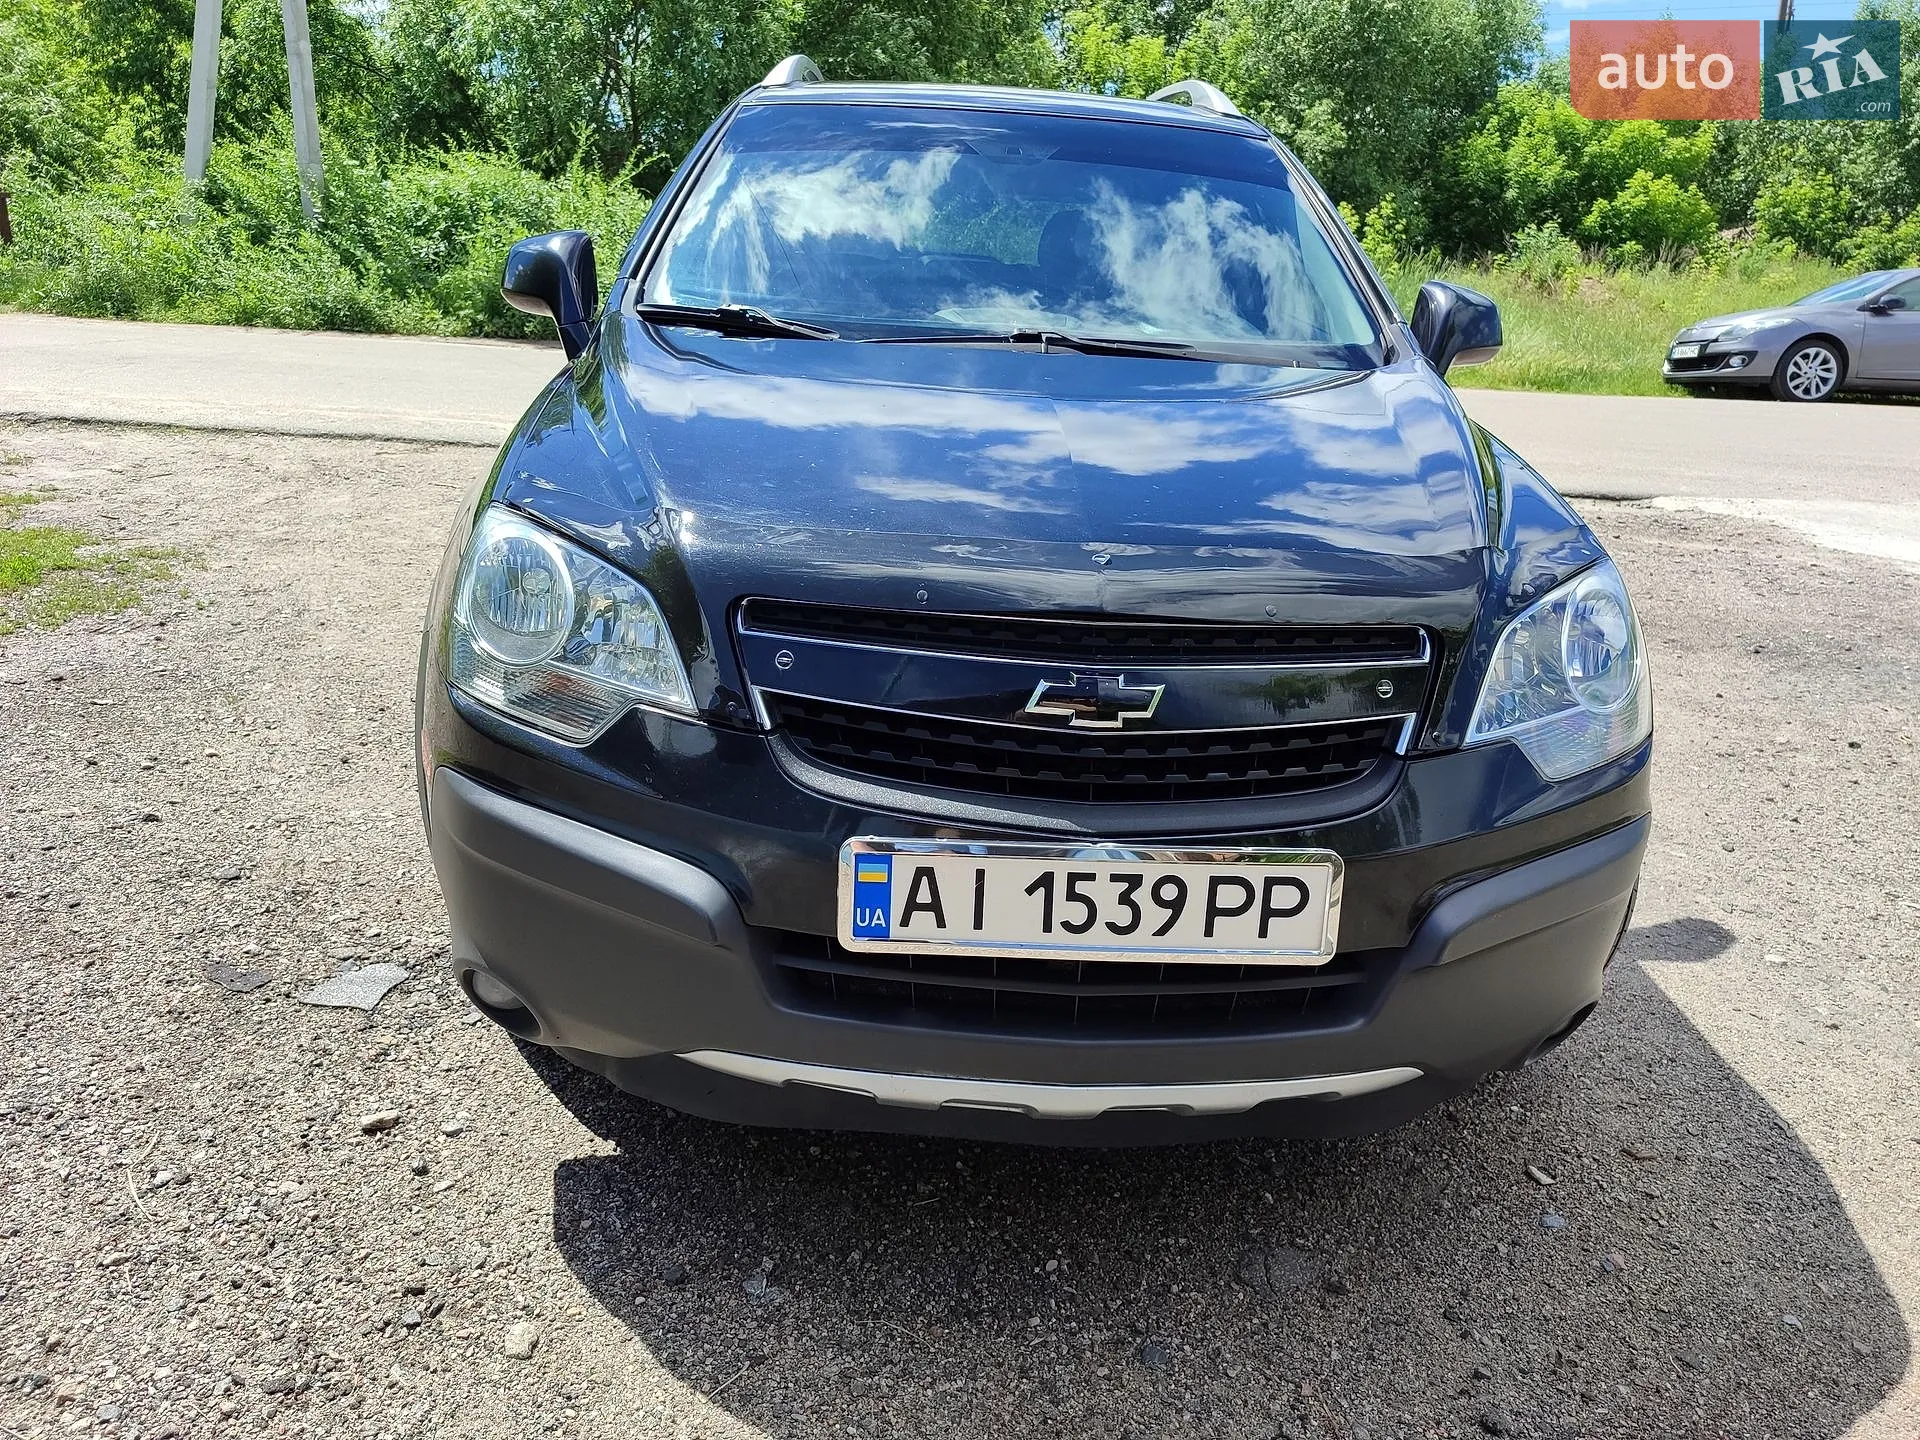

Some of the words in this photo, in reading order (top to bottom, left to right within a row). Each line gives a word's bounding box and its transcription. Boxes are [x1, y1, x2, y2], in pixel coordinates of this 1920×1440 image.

[856, 906, 887, 928] UA
[1023, 870, 1189, 936] 1539
[1203, 874, 1311, 939] PP
